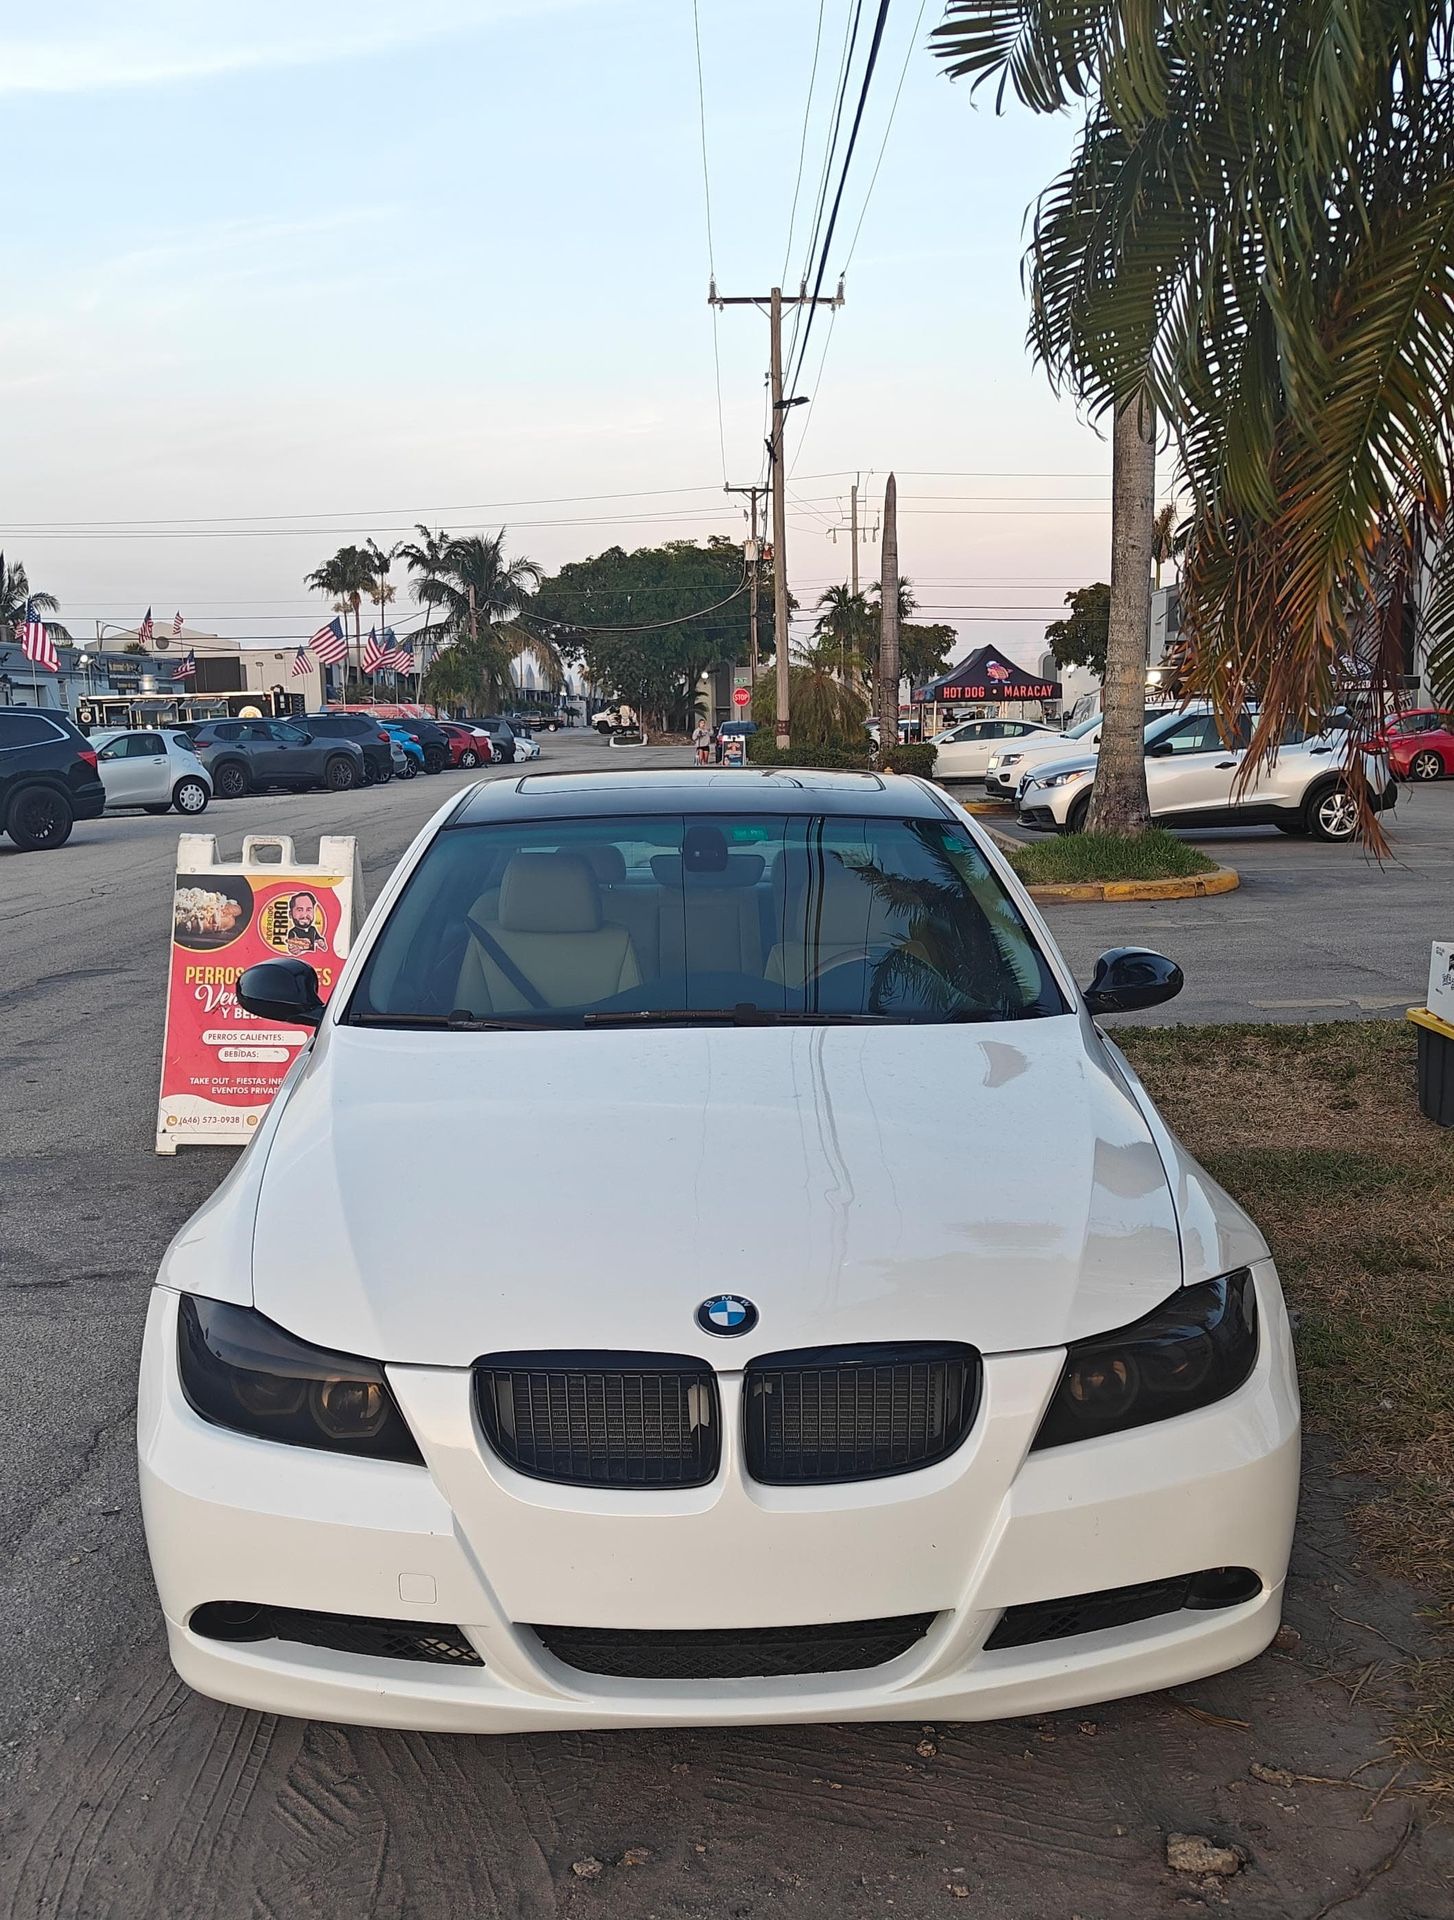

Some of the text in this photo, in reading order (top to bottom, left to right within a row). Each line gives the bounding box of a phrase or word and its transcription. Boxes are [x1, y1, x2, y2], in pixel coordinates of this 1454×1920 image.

[943, 685, 1053, 699] HOT DOG MARACAY
[734, 693, 749, 702] STOP
[272, 901, 289, 945] PERRO
[208, 1033, 285, 1042] PERROS CALIENTES:
[190, 1077, 209, 1085] TAKE
[211, 1077, 229, 1085] OUT
[236, 1077, 267, 1085] FIESTAS
[211, 1086, 249, 1095] EVENTOS
[179, 1115, 241, 1125] (646) 573-0938
